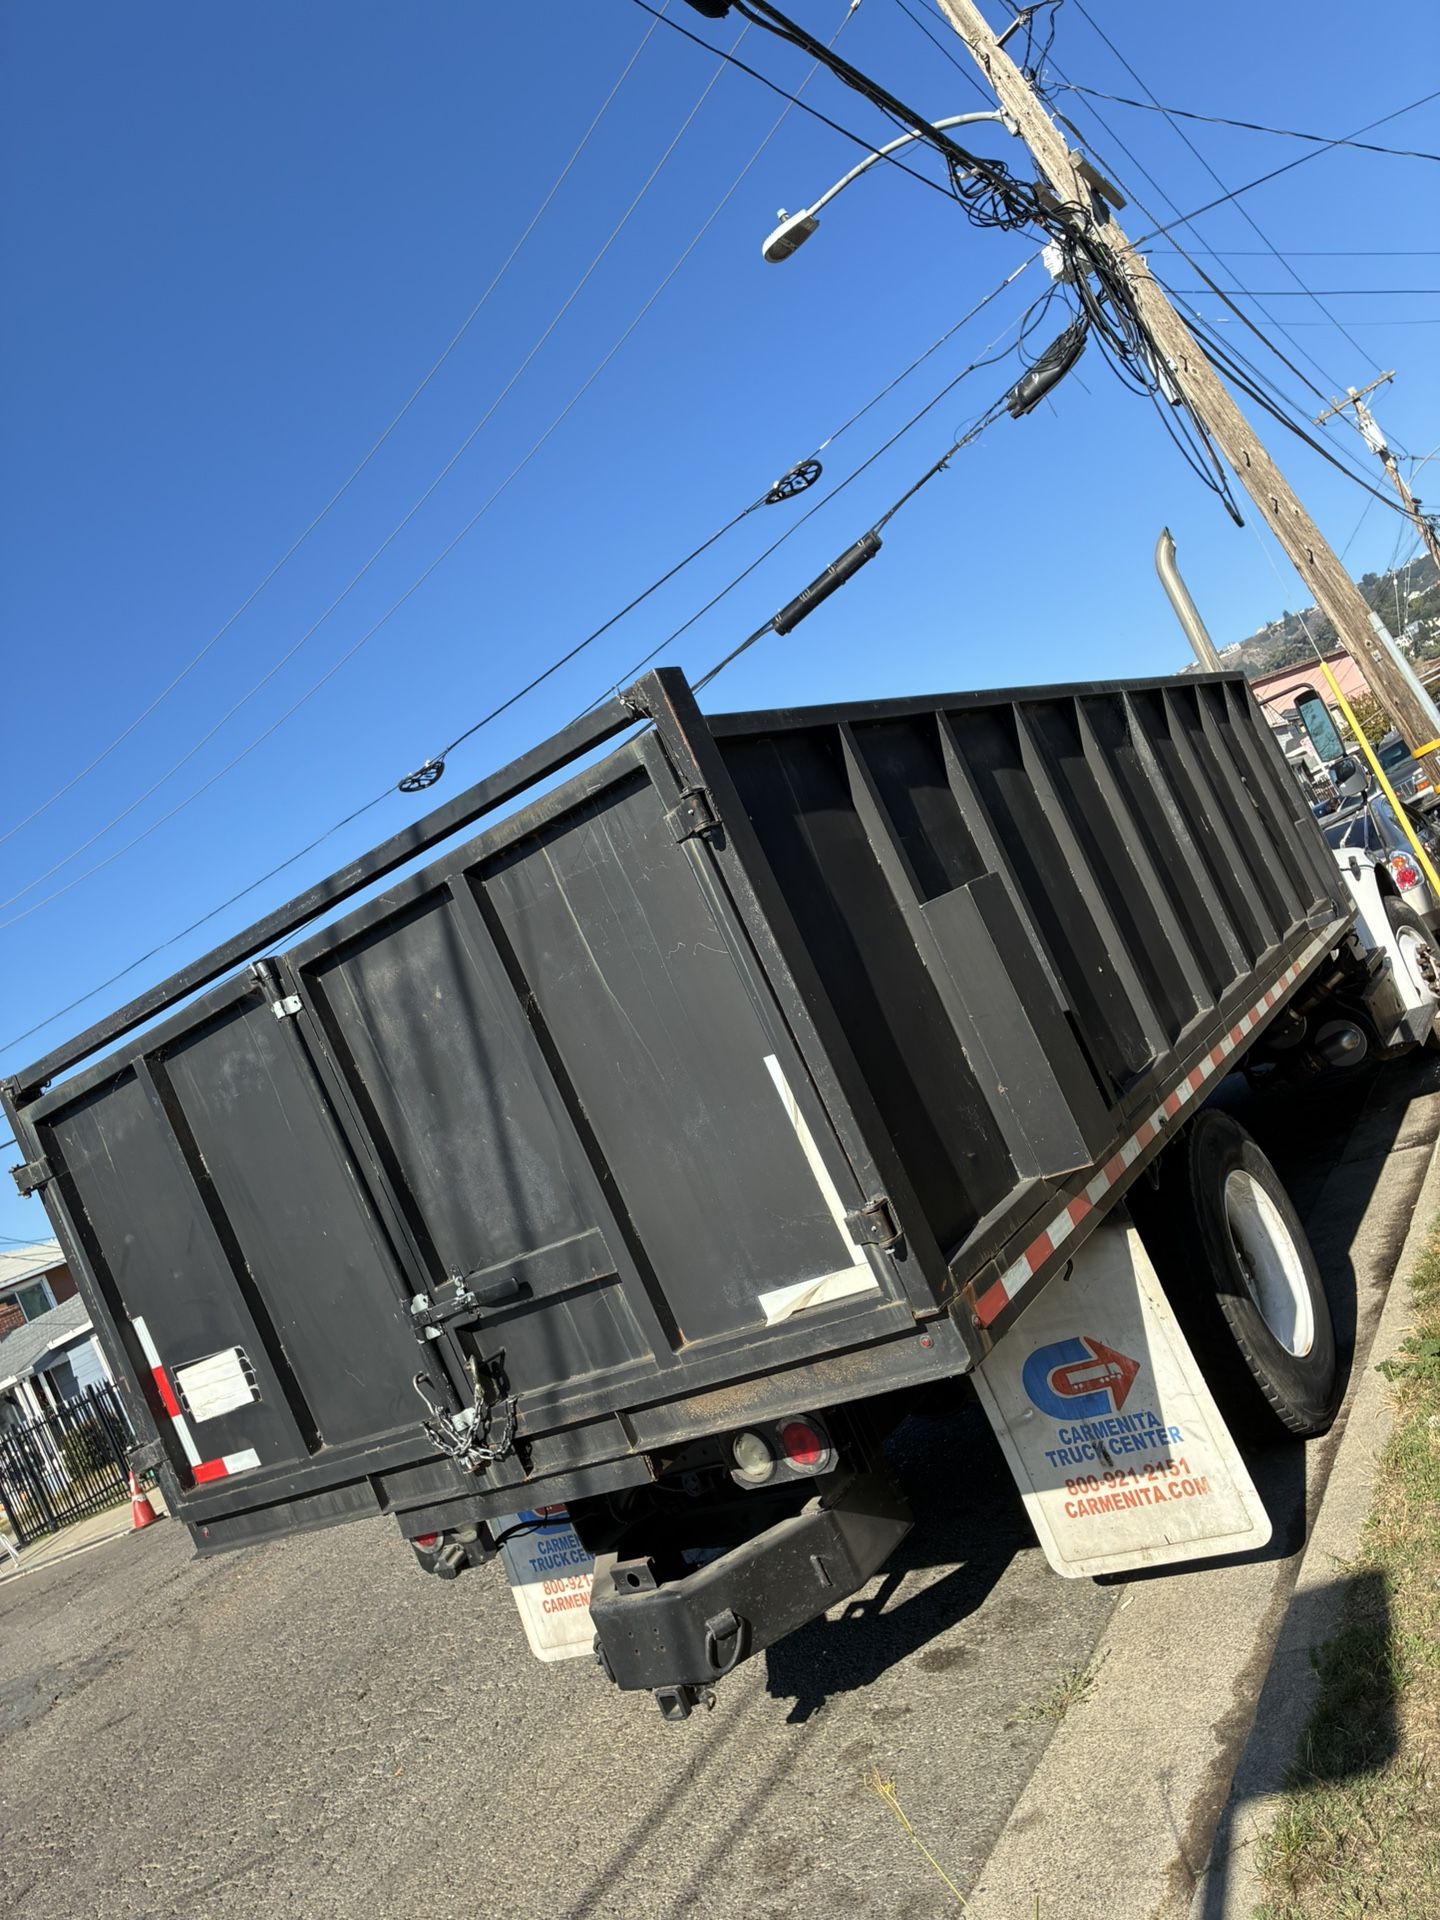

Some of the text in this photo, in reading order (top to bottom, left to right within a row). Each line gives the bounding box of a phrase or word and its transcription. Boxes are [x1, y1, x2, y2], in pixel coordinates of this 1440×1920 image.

[1045, 1426, 1184, 1468] TRUCK CENTER
[1058, 1411, 1161, 1445] CARMENITA
[1065, 1457, 1191, 1496] 800-921-2151
[1064, 1476, 1210, 1518] CARMENITA.COM
[529, 1550, 571, 1572] TRUCK
